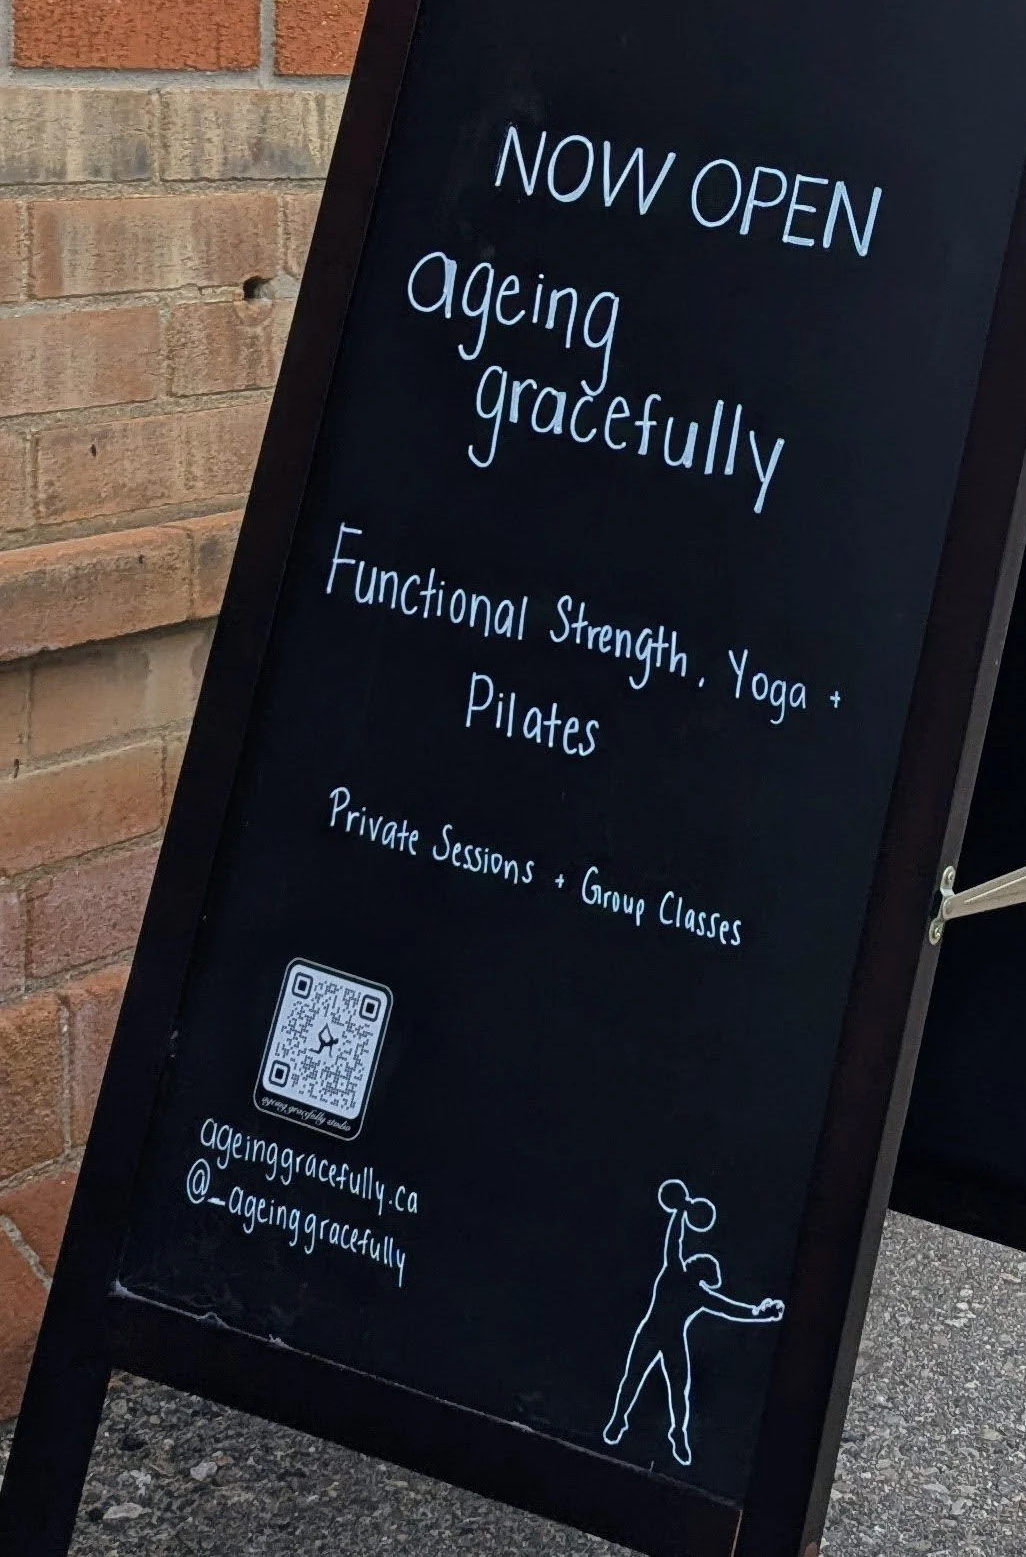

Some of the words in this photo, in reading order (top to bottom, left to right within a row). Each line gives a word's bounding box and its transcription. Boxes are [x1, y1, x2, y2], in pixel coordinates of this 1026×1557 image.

[495, 125, 677, 215] NOW
[691, 158, 882, 257] OPEN
[407, 251, 619, 396] ageing
[468, 365, 785, 514] gracefully
[326, 522, 529, 640] Functional
[728, 649, 807, 725] Yoga
[465, 671, 600, 756] Pilates
[329, 786, 420, 855] Private
[432, 824, 535, 884] Sessions
[581, 867, 645, 927] Group
[659, 891, 742, 946] Classes
[186, 1158, 406, 1287] @_ageinggracefully
[200, 1118, 419, 1216] ageinggracefully.ca
